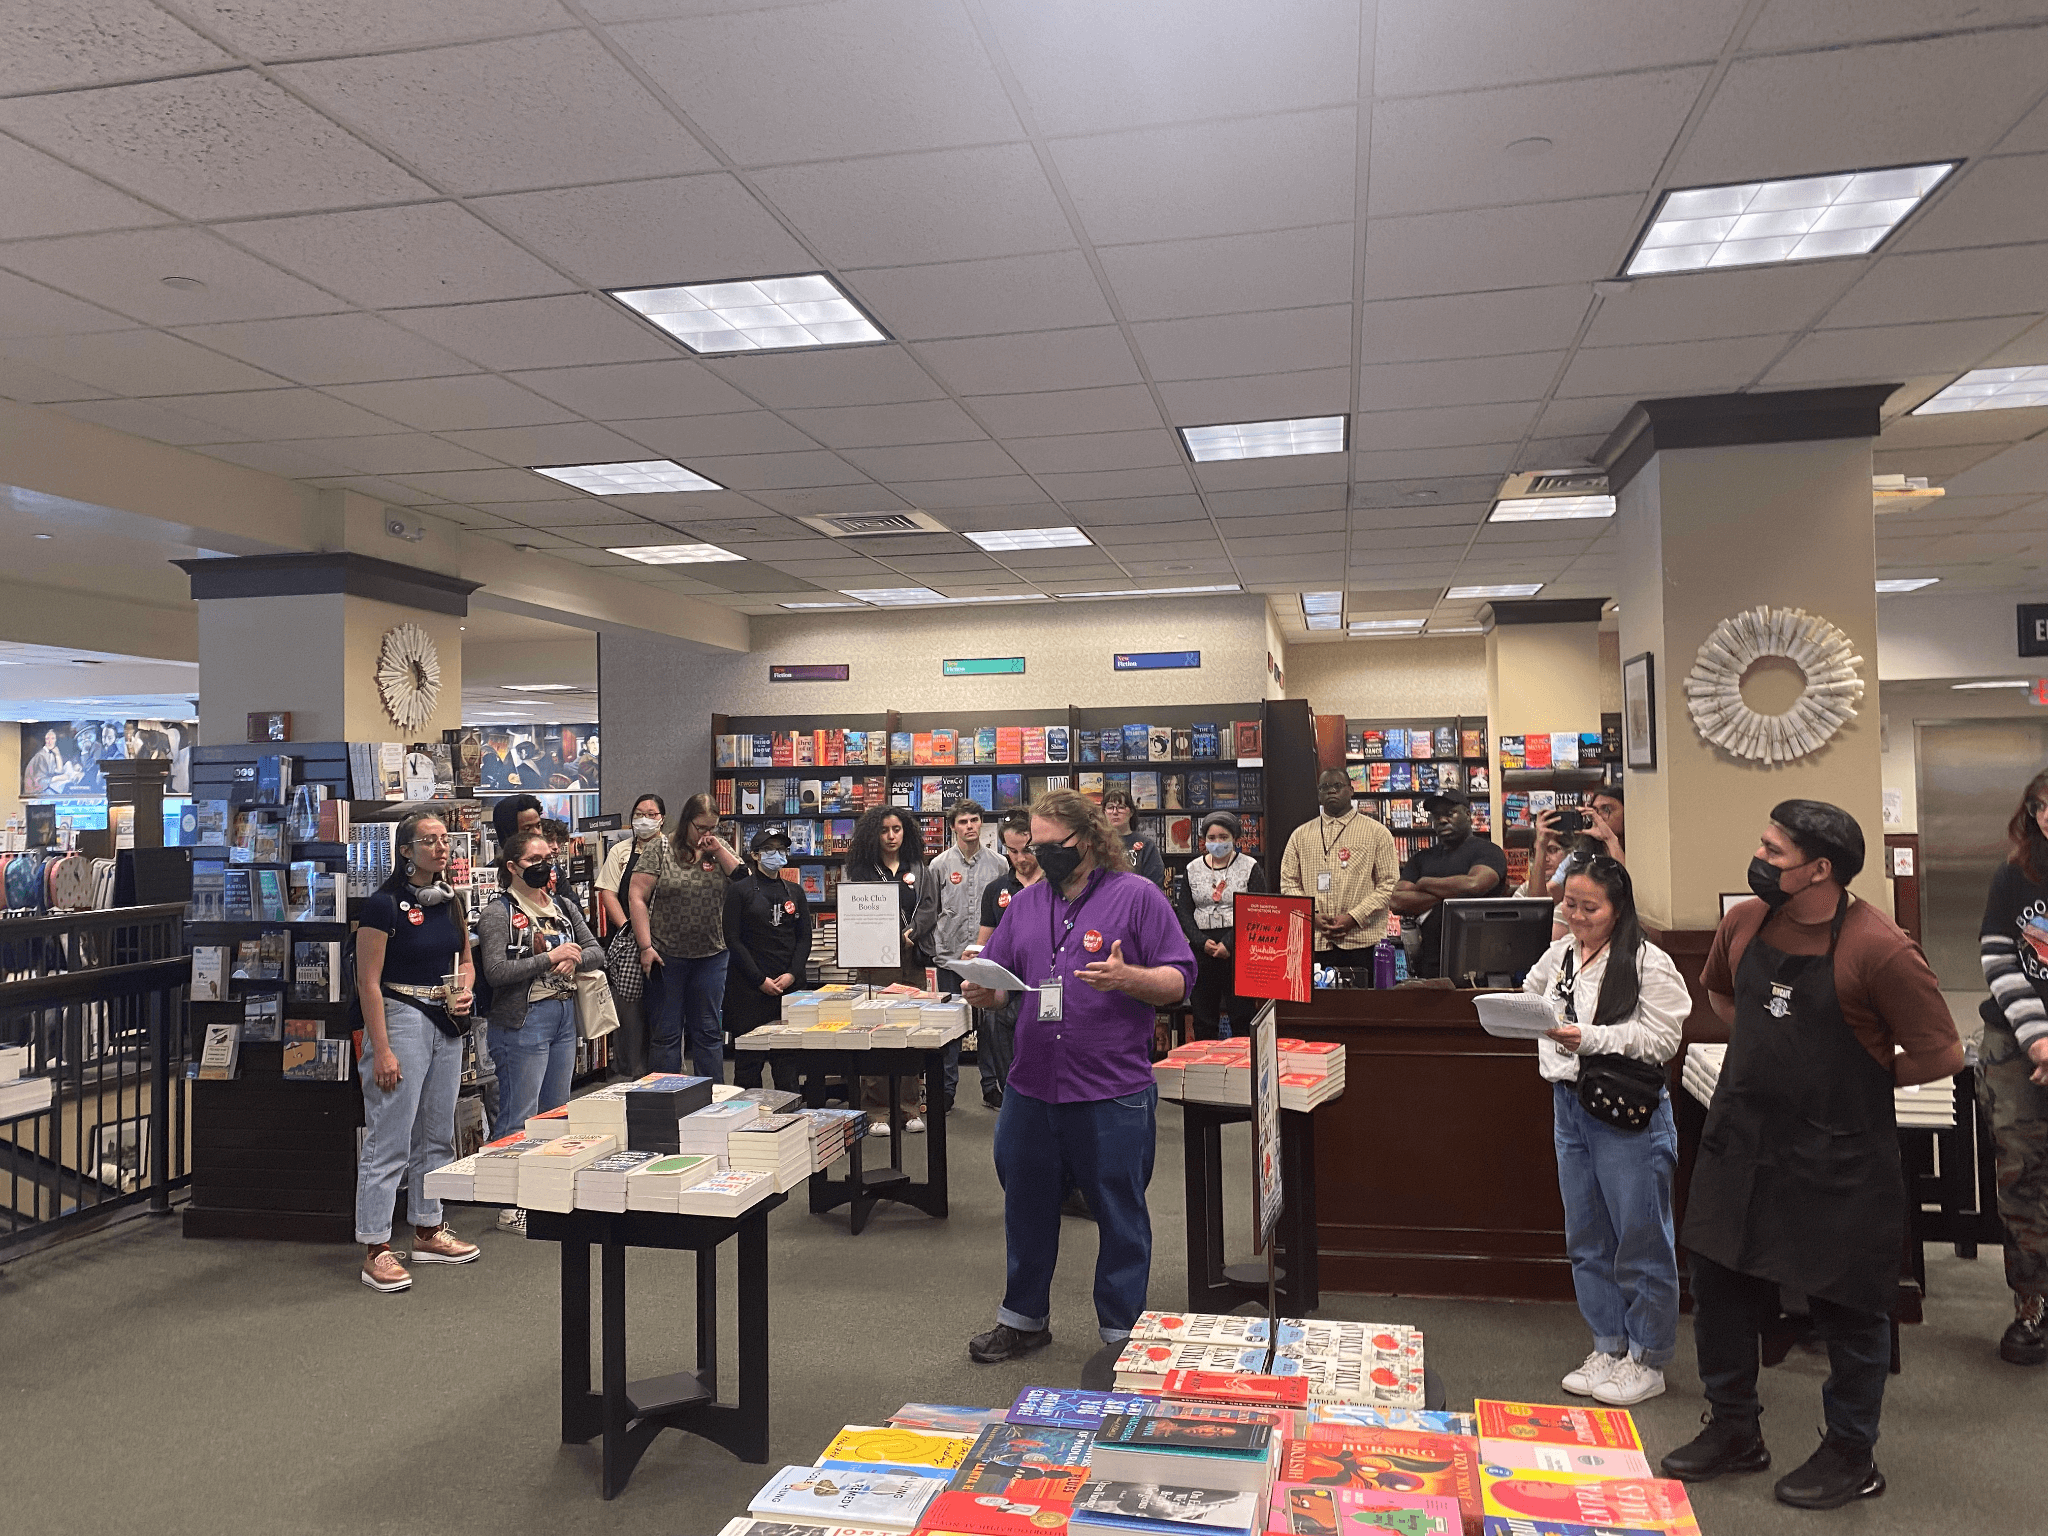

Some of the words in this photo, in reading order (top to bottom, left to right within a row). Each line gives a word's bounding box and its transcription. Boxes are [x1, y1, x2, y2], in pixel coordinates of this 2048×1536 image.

[942, 777, 963, 785] VenCo
[942, 790, 963, 798] VenCo
[589, 821, 599, 829] Local
[851, 894, 869, 902] Book
[870, 894, 887, 902] Club
[858, 903, 880, 911] Books
[1246, 922, 1272, 932] CRYING
[1274, 925, 1284, 933] IN
[1084, 934, 1102, 942] Union
[1248, 932, 1257, 942] H
[1257, 936, 1279, 944] MART
[1100, 1401, 1126, 1417] SAV
[1063, 1439, 1086, 1467] MADURAI
[1287, 1441, 1307, 1479] HISTORY
[1453, 1453, 1469, 1470] OZA
[838, 1483, 865, 1509] REMEDY
[893, 1480, 914, 1499] LIVING
[1080, 1491, 1106, 1509] Vuong
[1574, 1485, 1613, 1525] ENTRA
[1614, 1484, 1654, 1523] LACES
